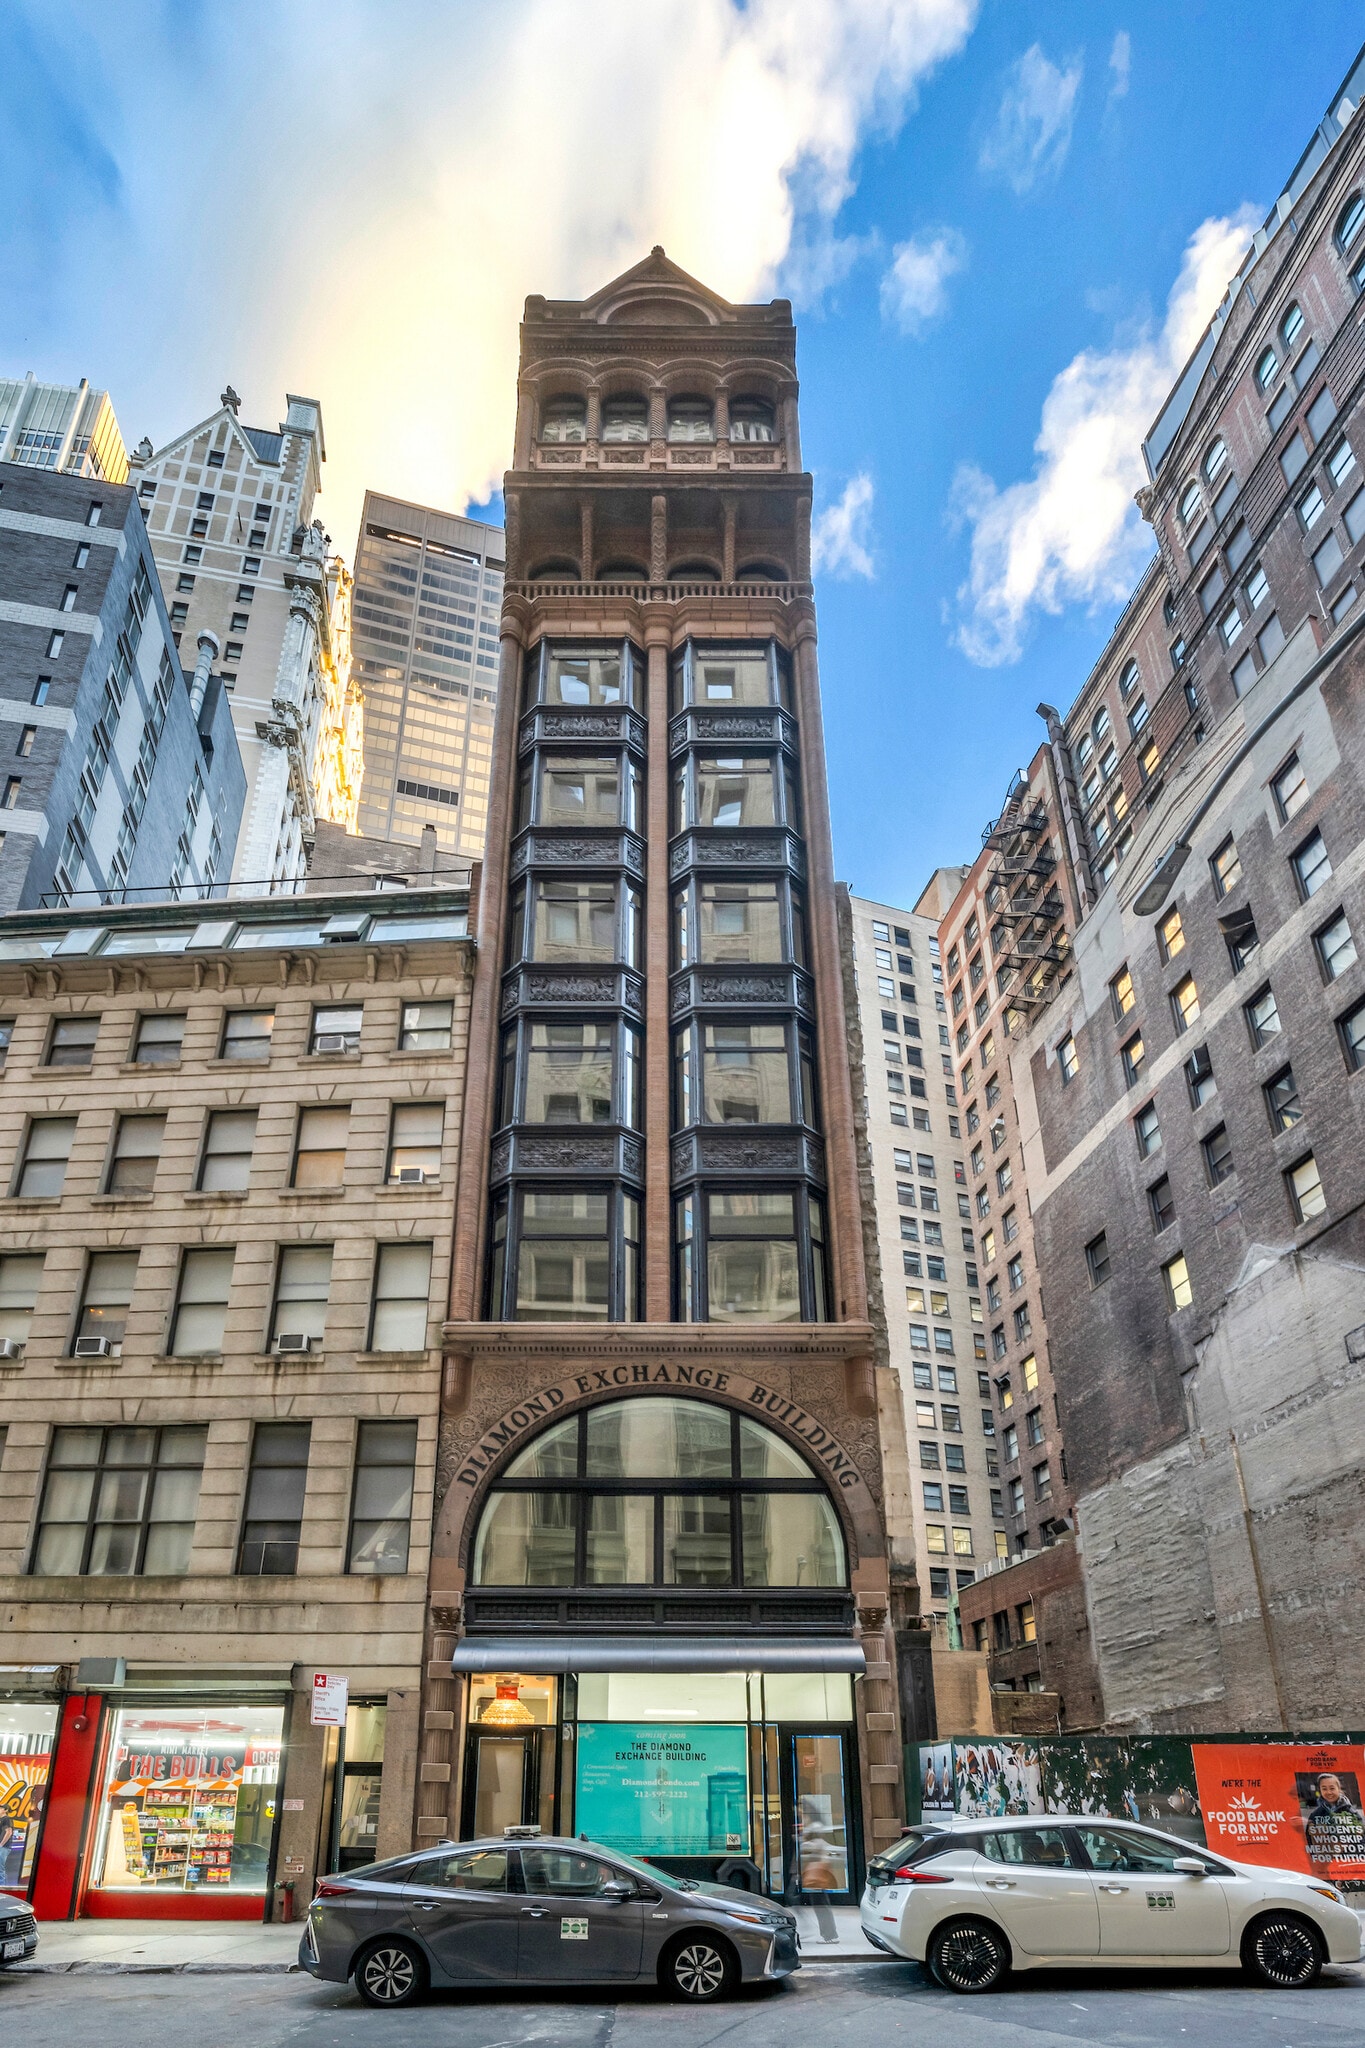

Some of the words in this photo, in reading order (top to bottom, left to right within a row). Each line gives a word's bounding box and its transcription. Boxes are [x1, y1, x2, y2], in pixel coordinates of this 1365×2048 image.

[457, 1388, 564, 1488] DIAMOND
[574, 1364, 730, 1394] EXCHANGE
[748, 1385, 860, 1489] BUILDING
[160, 1746, 177, 1755] MINI
[181, 1746, 208, 1755] MARKET
[631, 1742, 647, 1751] THE
[651, 1742, 691, 1751] DIAMOND
[615, 1752, 662, 1760] EXCHANGE
[666, 1752, 707, 1761] BUILDING
[129, 1755, 164, 1779] THE
[169, 1755, 235, 1780] BULLS
[622, 1778, 700, 1786] DiamondCondo.com
[1222, 1779, 1243, 1787] WE'RE
[1248, 1779, 1262, 1787] THE
[1207, 1811, 1245, 1822] FOOD
[1247, 1810, 1286, 1822] BANK
[1314, 1815, 1331, 1824] FOR
[1333, 1816, 1353, 1824] THE
[1219, 1823, 1248, 1835] FOR
[1249, 1823, 1278, 1834] NYC
[1309, 1825, 1363, 1834] STUDENTS
[1313, 1834, 1338, 1843] WHO
[1340, 1835, 1363, 1843] SKIP
[1305, 1844, 1341, 1853] MEALS
[1341, 1845, 1356, 1853] TO
[1311, 1854, 1333, 1863] FOR
[1148, 1896, 1173, 1907] DOT
[562, 1922, 587, 1933] DOT
